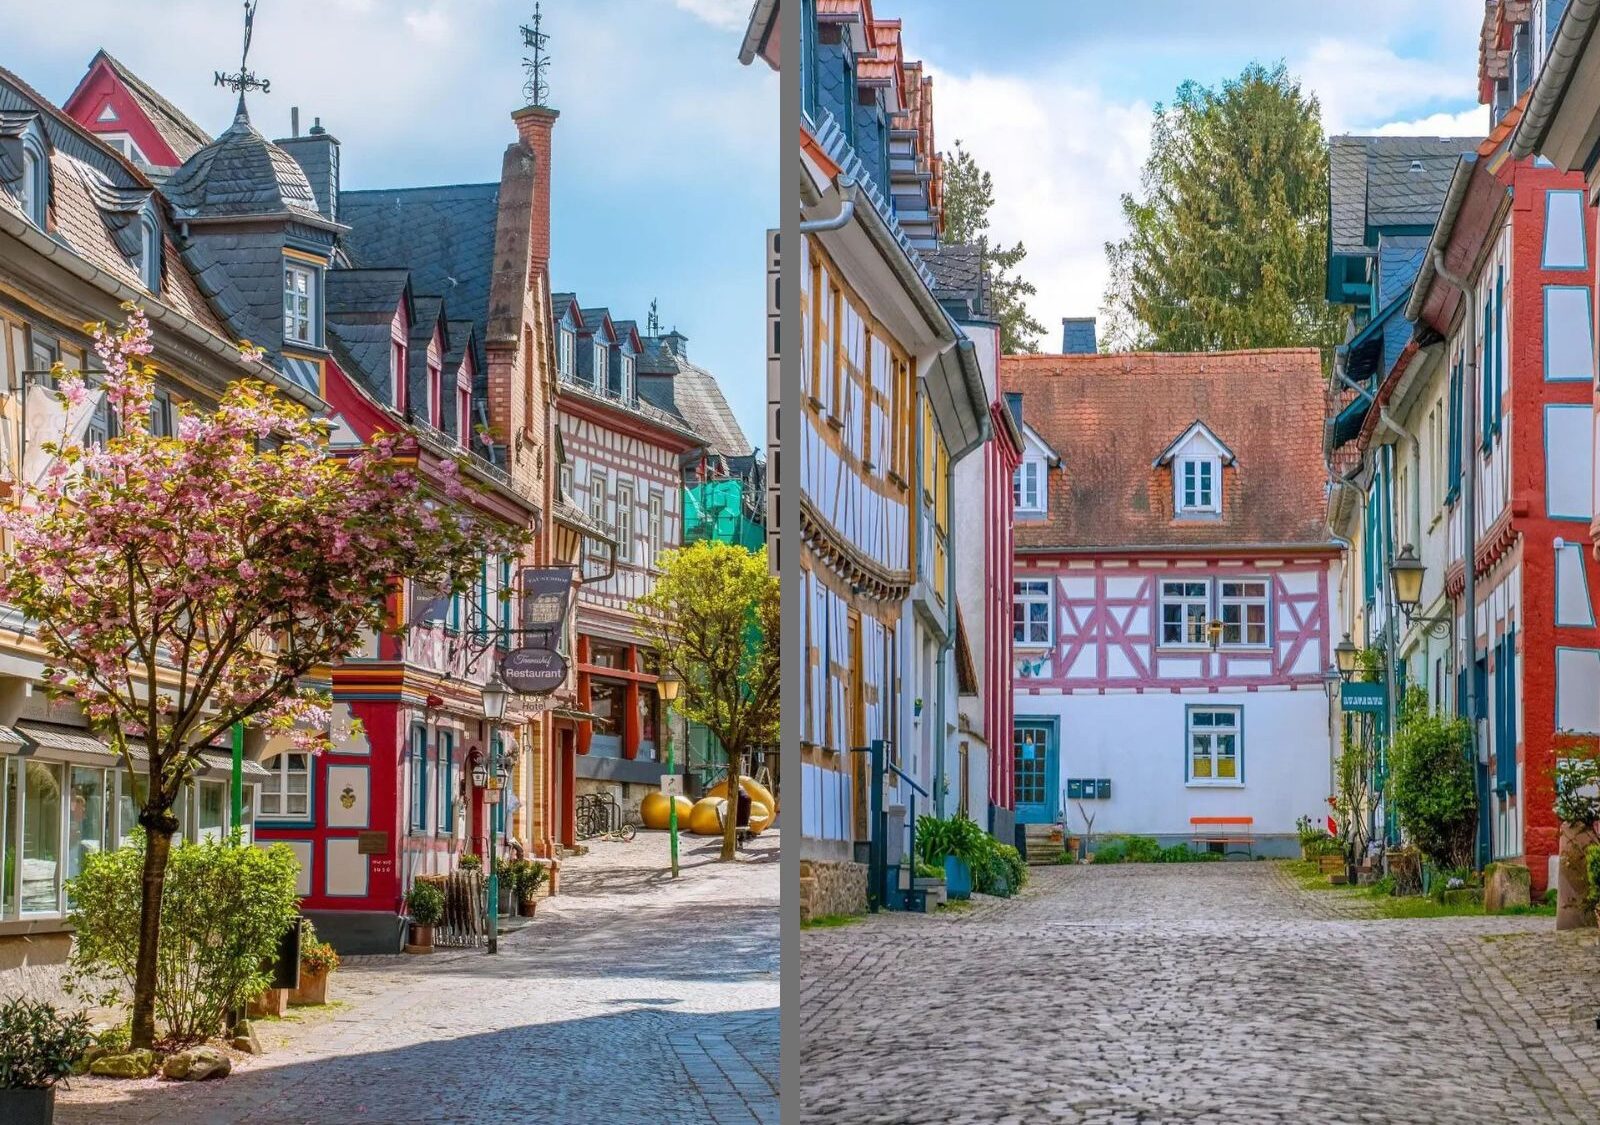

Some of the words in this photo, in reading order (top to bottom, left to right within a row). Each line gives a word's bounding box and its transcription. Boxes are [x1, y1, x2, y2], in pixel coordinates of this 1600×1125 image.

[214, 71, 225, 87] N
[506, 668, 561, 678] Restaurant
[522, 701, 546, 711] Hotel
